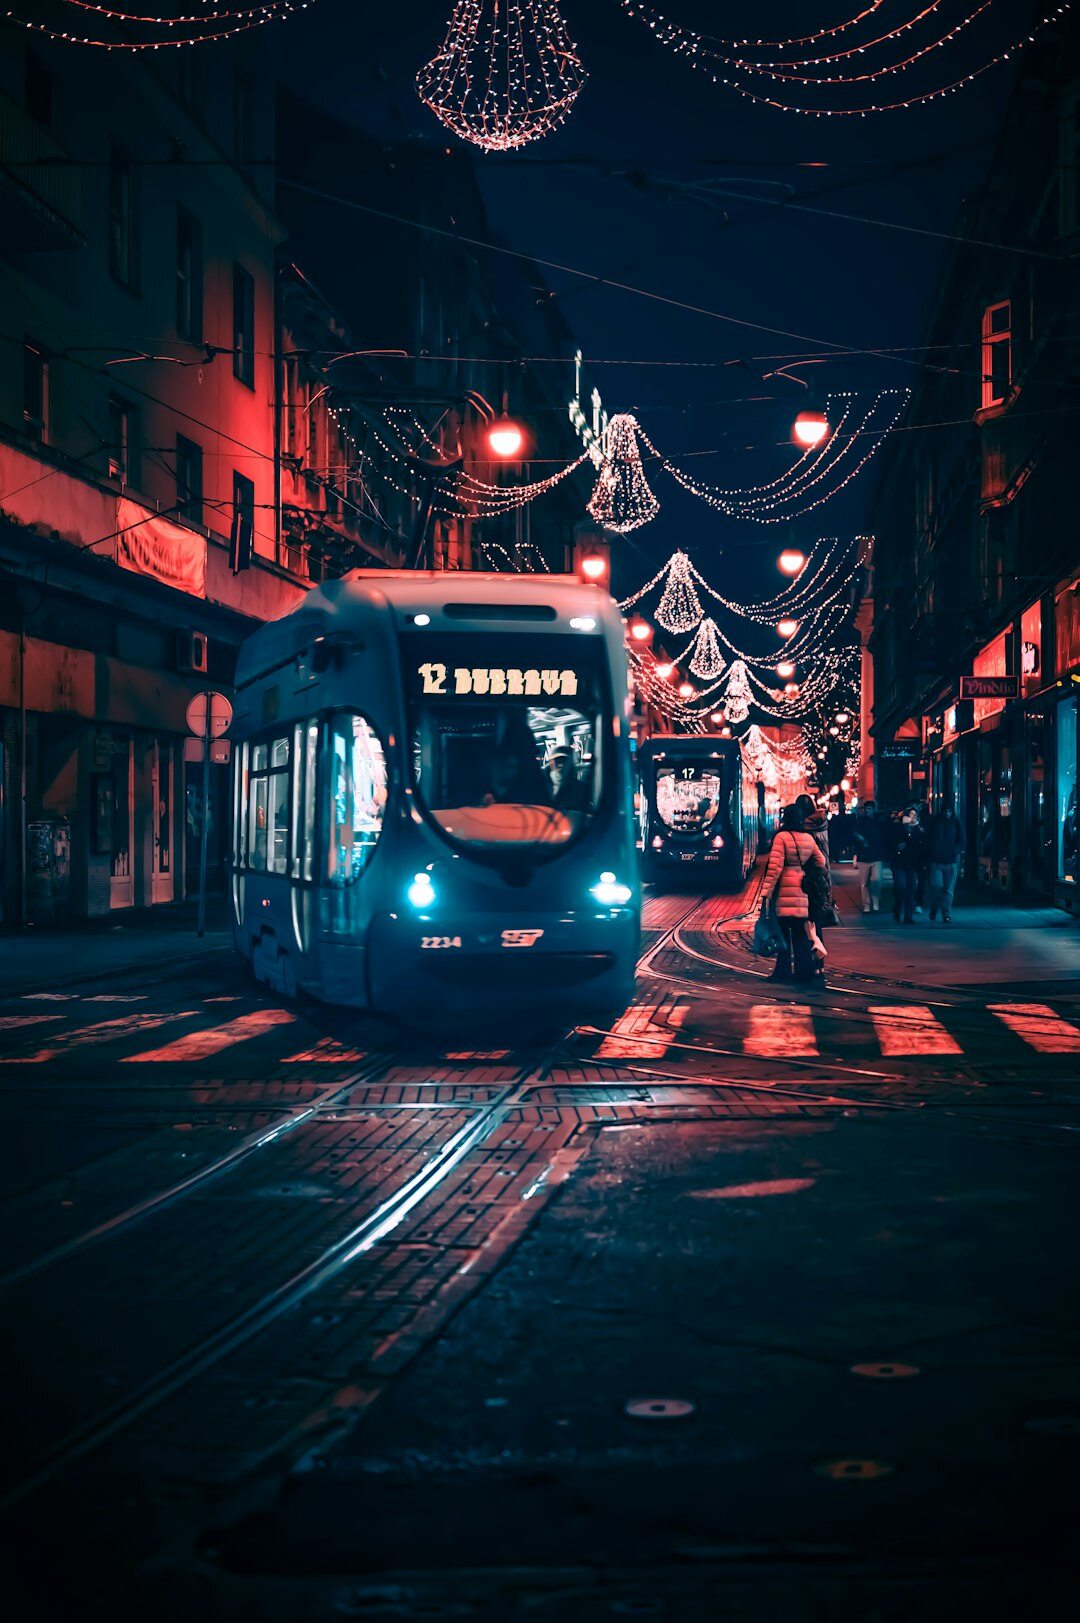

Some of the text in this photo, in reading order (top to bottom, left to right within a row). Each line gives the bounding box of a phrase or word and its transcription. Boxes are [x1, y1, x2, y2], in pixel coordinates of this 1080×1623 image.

[418, 663, 578, 696] 12 DUBRAVA
[682, 768, 695, 779] 17
[420, 936, 462, 949] 2234
